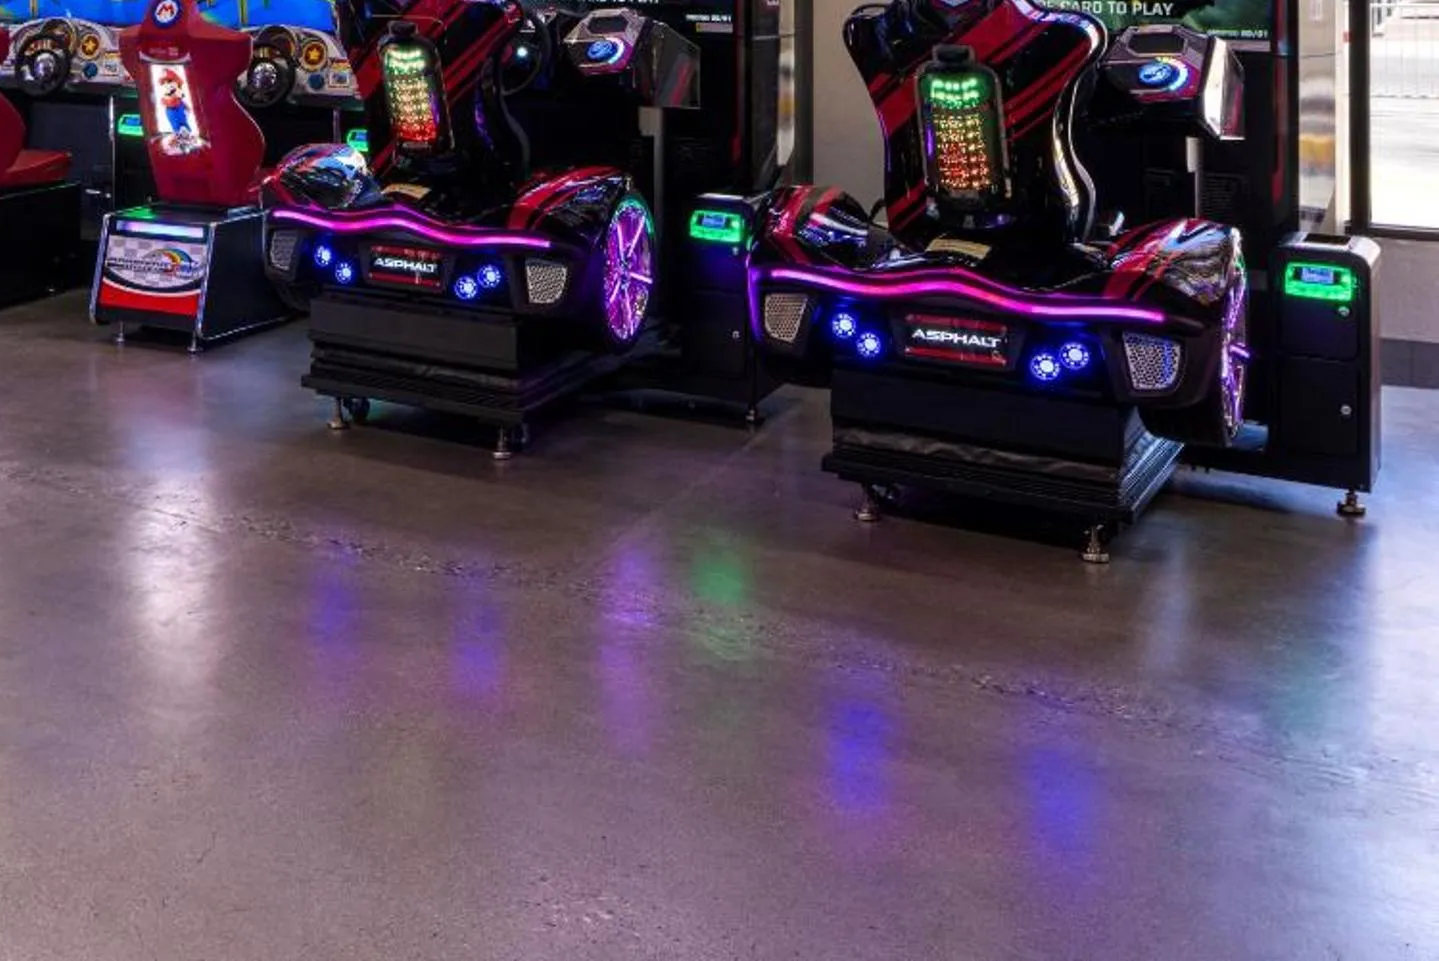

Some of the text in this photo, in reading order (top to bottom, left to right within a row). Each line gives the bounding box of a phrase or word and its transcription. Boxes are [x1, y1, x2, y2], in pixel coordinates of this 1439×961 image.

[1109, 1, 1127, 14] TO
[1132, 1, 1174, 17] PLAY
[374, 257, 438, 273] ASPHALT
[912, 328, 1002, 348] ASPHALT
